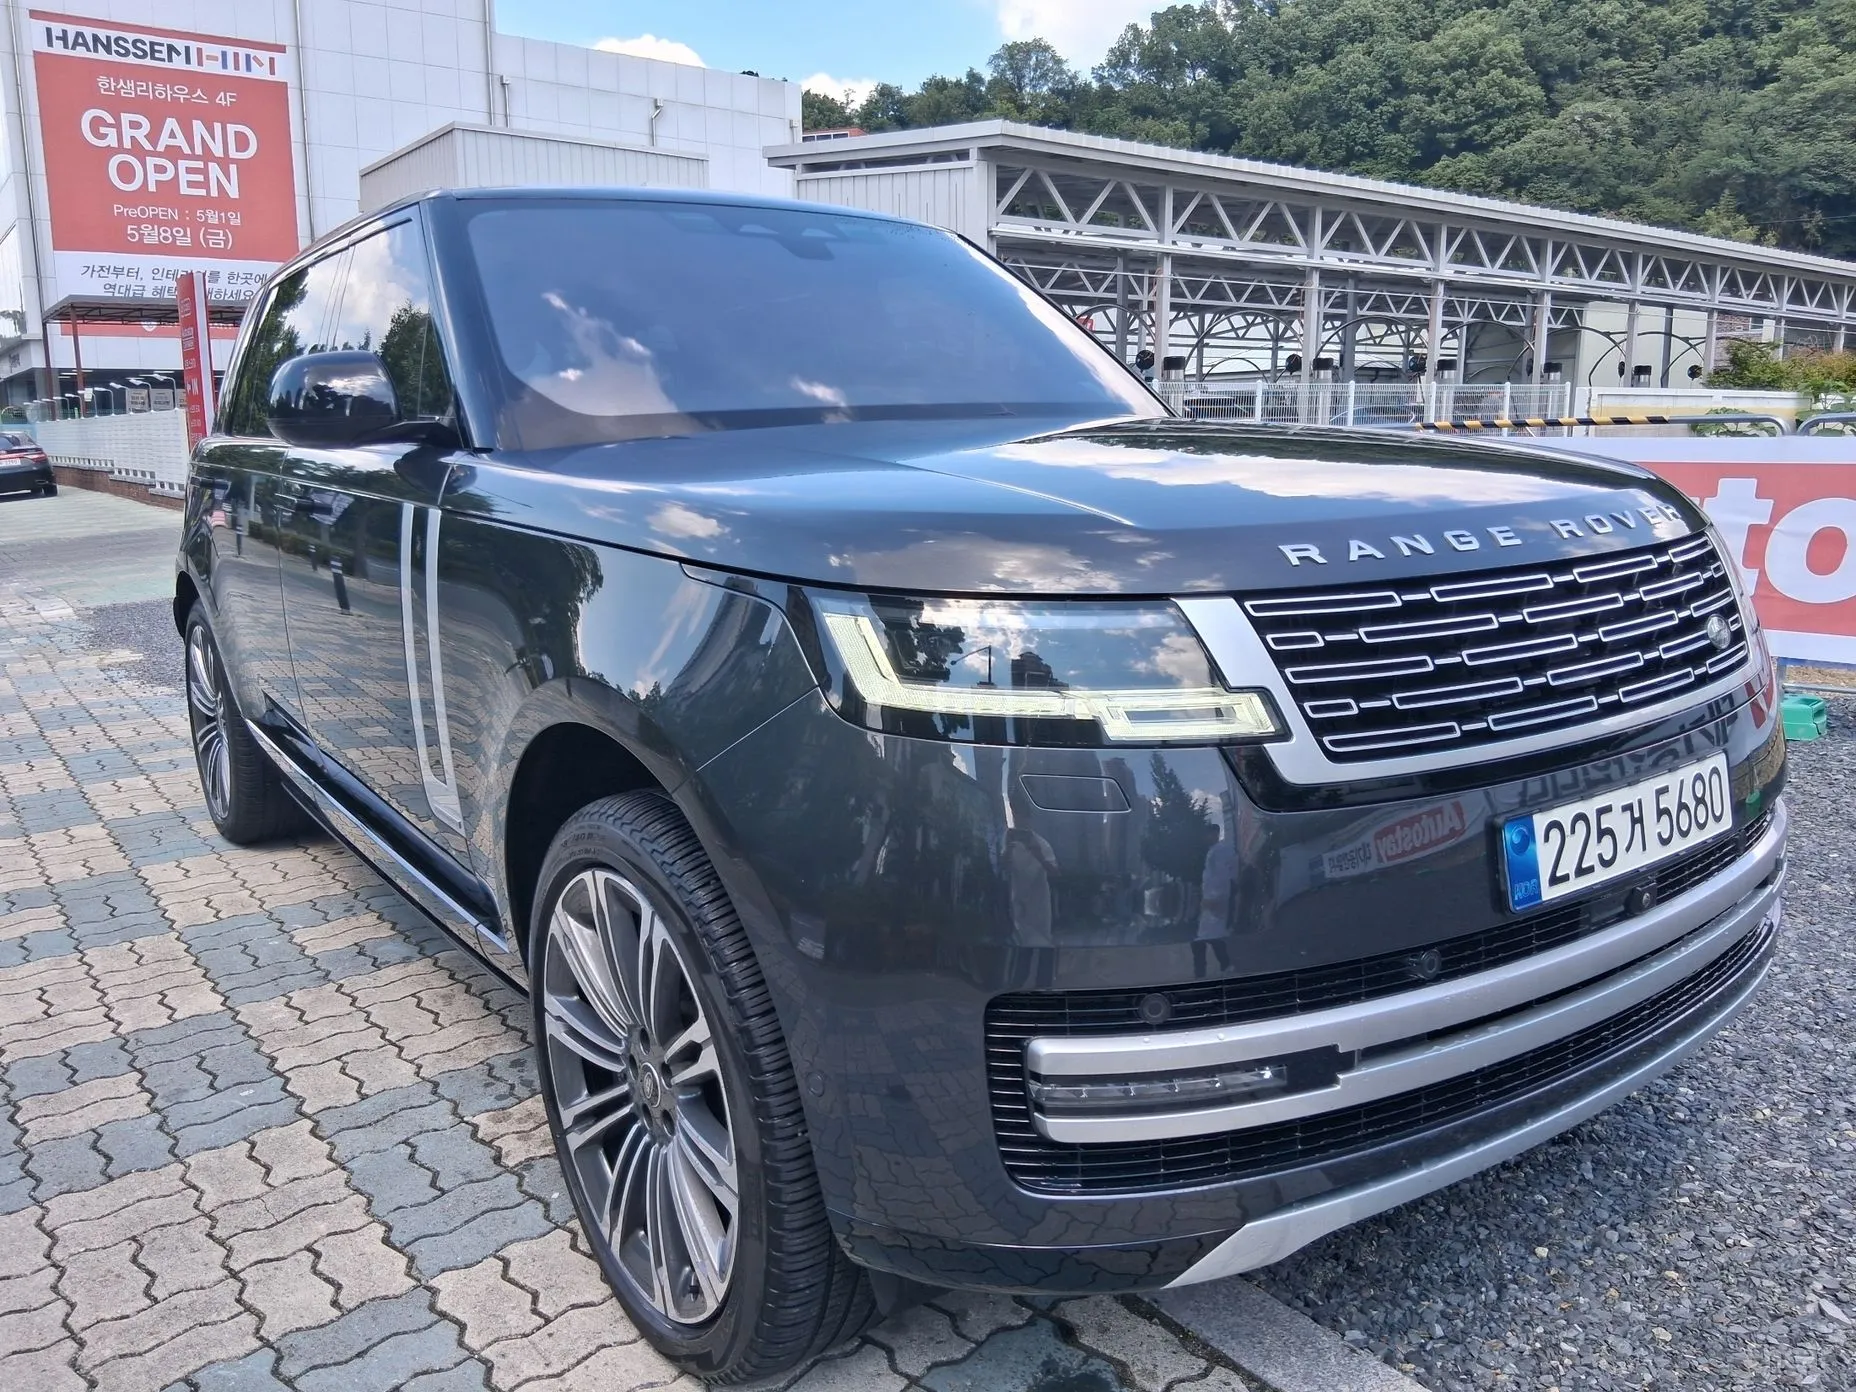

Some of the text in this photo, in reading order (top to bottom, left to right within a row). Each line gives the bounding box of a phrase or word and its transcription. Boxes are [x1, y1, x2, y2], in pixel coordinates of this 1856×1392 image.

[45, 27, 192, 65] HANSSEM
[97, 76, 237, 107] 한샘리하우스 4F
[80, 108, 258, 160] GRAND
[108, 154, 240, 199] OPEN
[113, 204, 179, 221] PreOPEN
[196, 209, 241, 226] 5월1일
[127, 224, 232, 250] 5월8일 (금)
[81, 264, 144, 281] 가전부터,
[151, 267, 221, 284] 인테를
[1277, 504, 1683, 567] RANGE ROVER
[1692, 478, 1856, 605] to
[1543, 766, 1725, 888] 225거 5680
